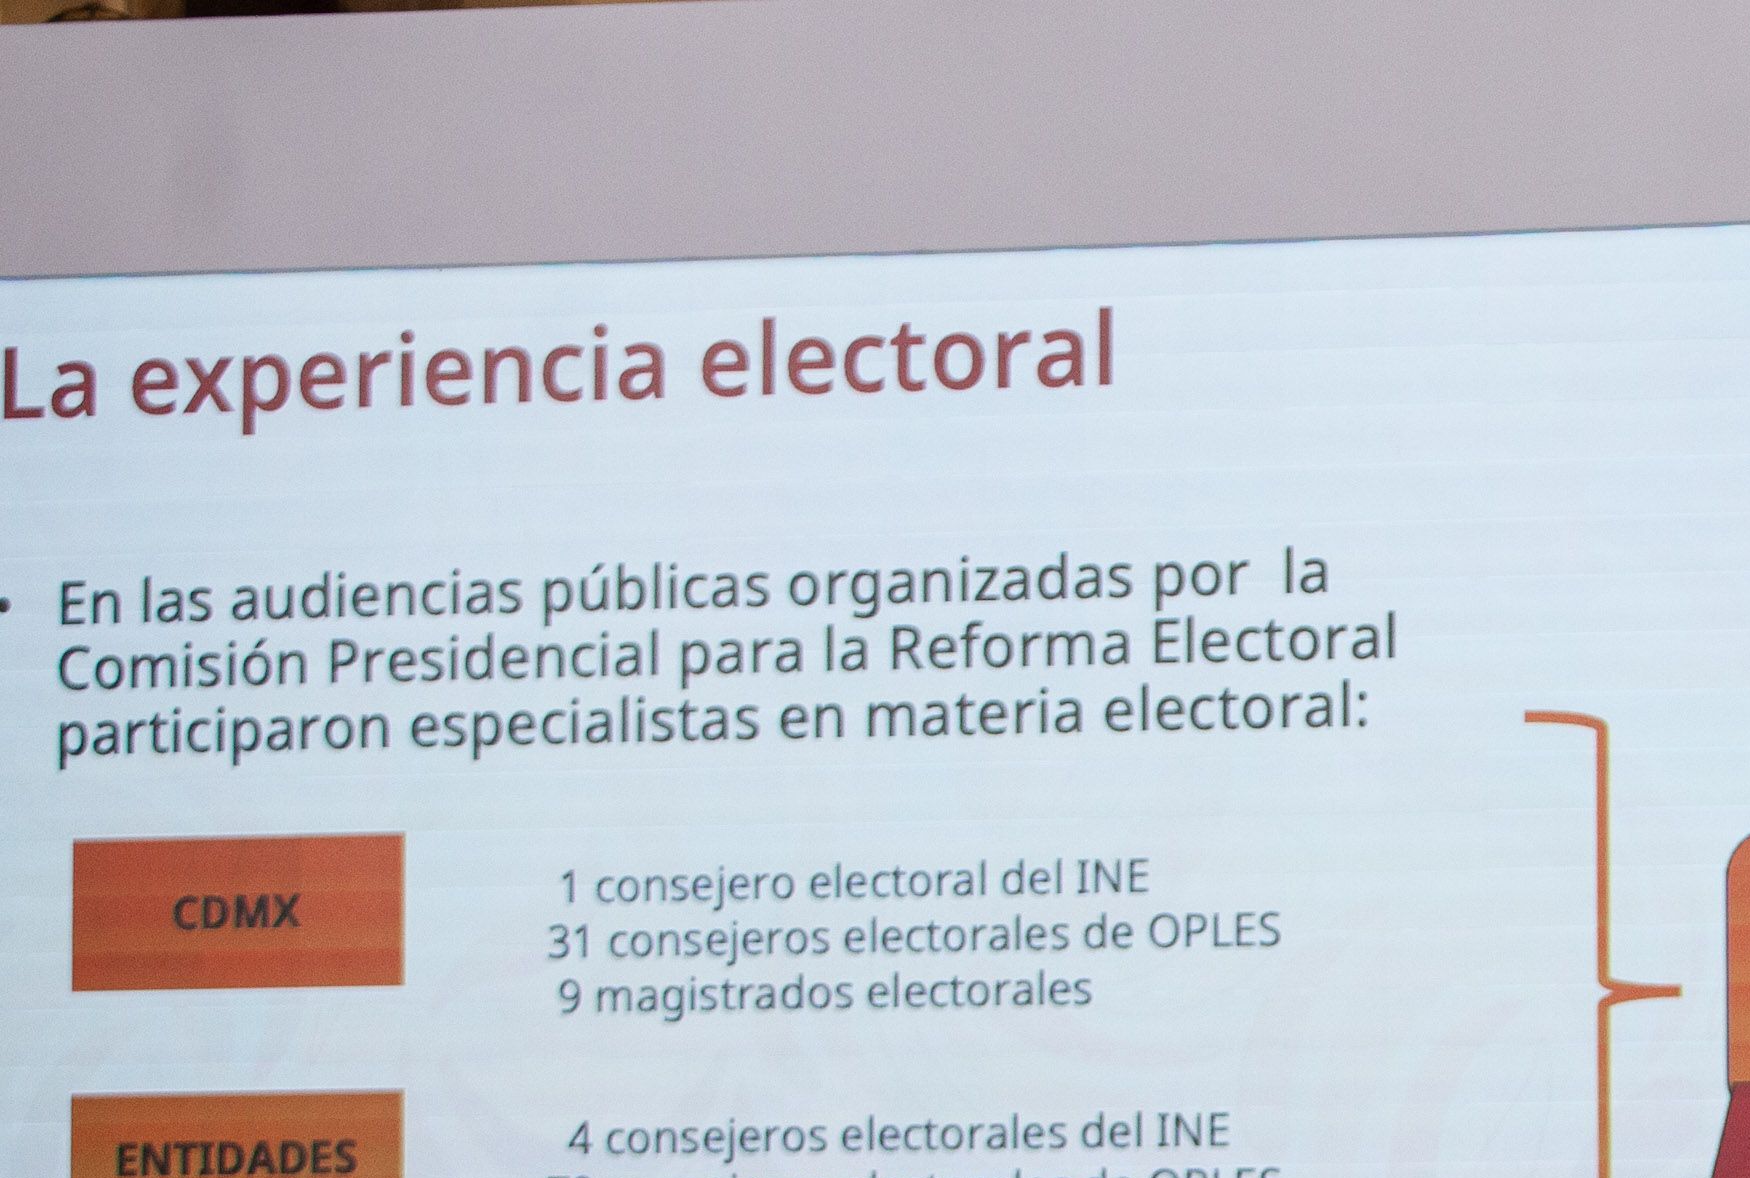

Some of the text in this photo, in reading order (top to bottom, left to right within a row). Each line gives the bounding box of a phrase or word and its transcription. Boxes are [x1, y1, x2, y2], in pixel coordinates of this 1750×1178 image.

[2, 306, 1114, 435] La experiencia electoral
[59, 546, 1329, 626] En las audiencias públicas organizadas por la
[58, 610, 1398, 690] Comisión Presidencial para la Reforma Electoral
[59, 680, 1369, 769] participaron especialistas en materia electoral:
[561, 859, 1149, 911] 1 consejero electoral del INE
[172, 893, 301, 931] CDMX
[547, 912, 1282, 966] 31 consejeros electorales de OPLES
[559, 970, 1093, 1022] 9 magistrados electorales
[116, 1139, 357, 1177] ENTIDADES
[569, 1112, 1230, 1164] 4 consejeros electorales del INE
